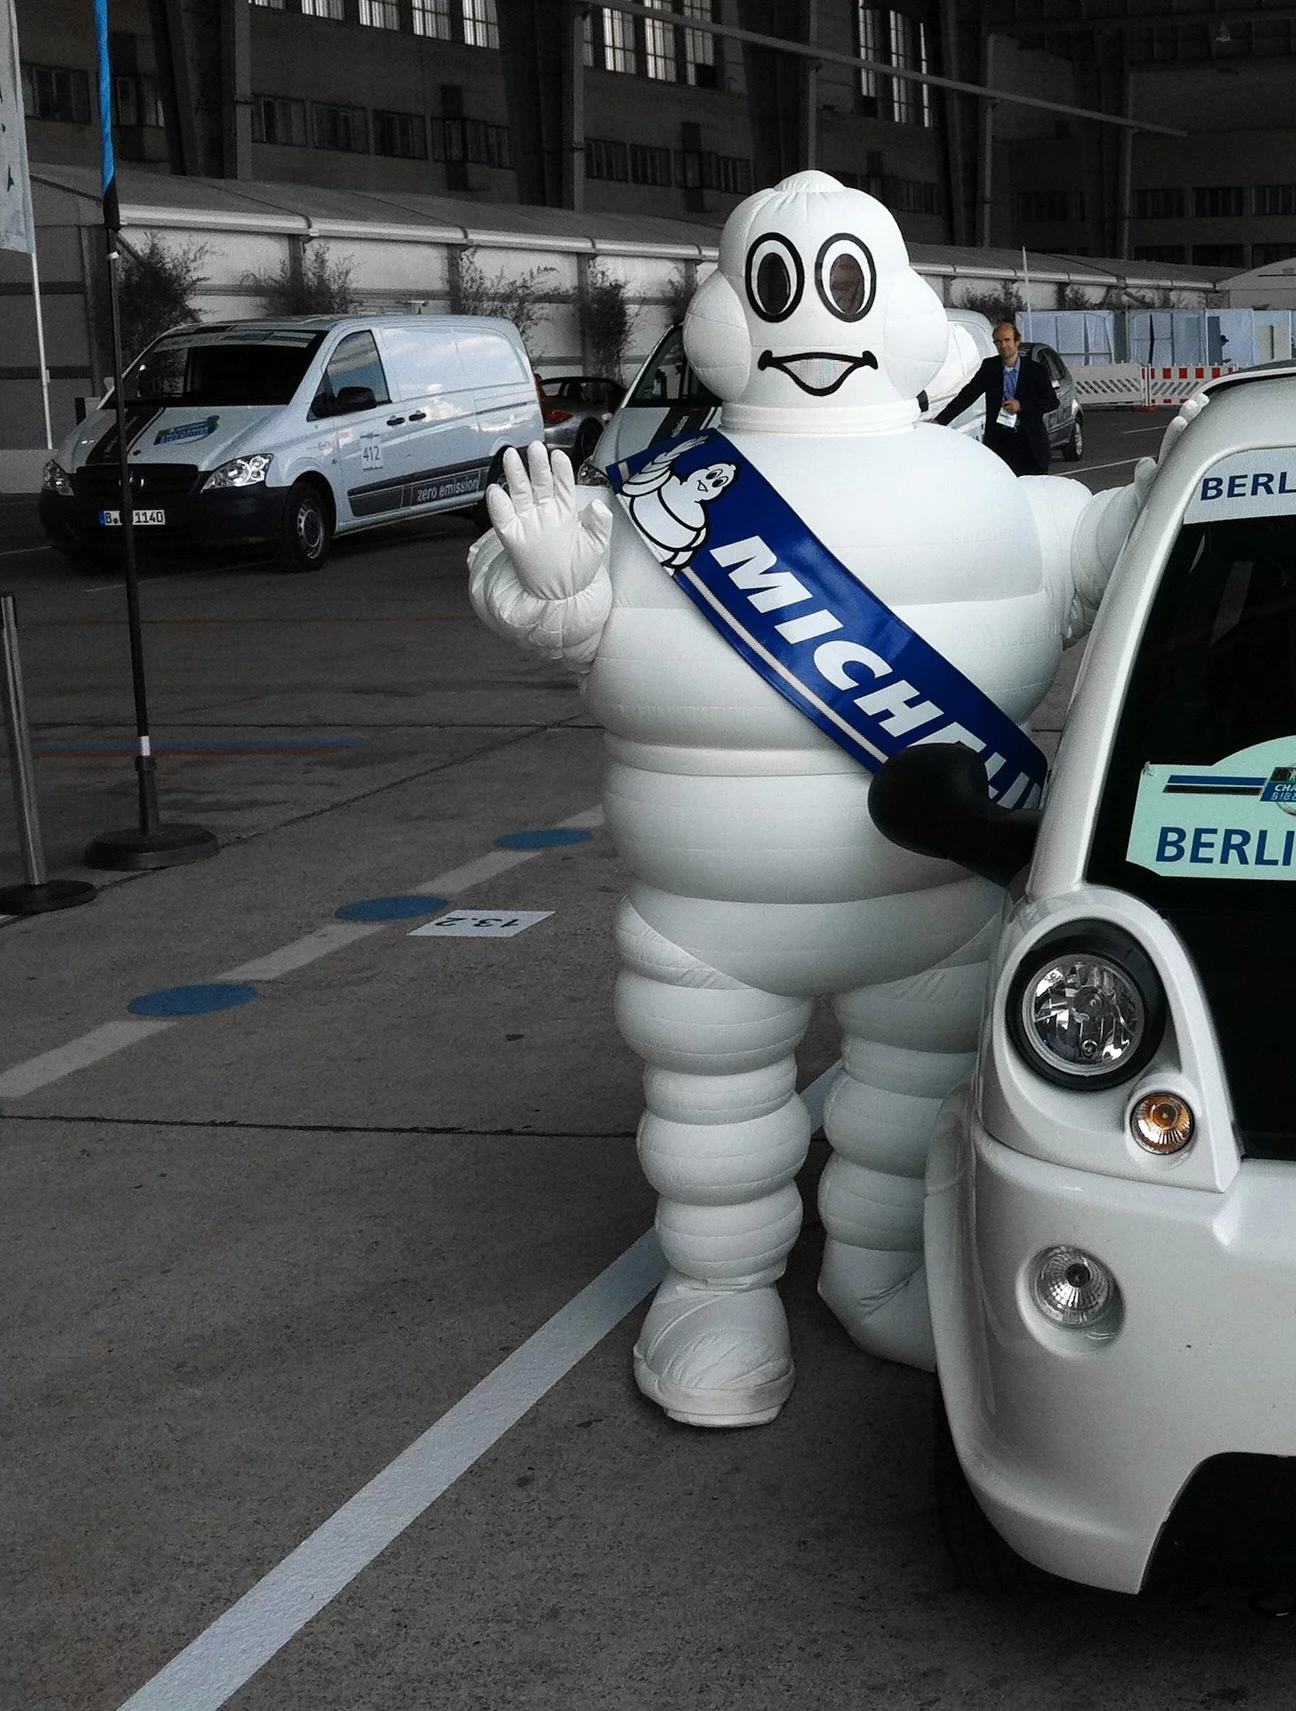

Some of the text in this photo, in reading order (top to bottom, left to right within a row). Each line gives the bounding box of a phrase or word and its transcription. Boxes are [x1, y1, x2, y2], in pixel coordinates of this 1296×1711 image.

[363, 446, 380, 461] 412
[417, 475, 480, 502] zero emission
[709, 534, 1042, 810] MICHI
